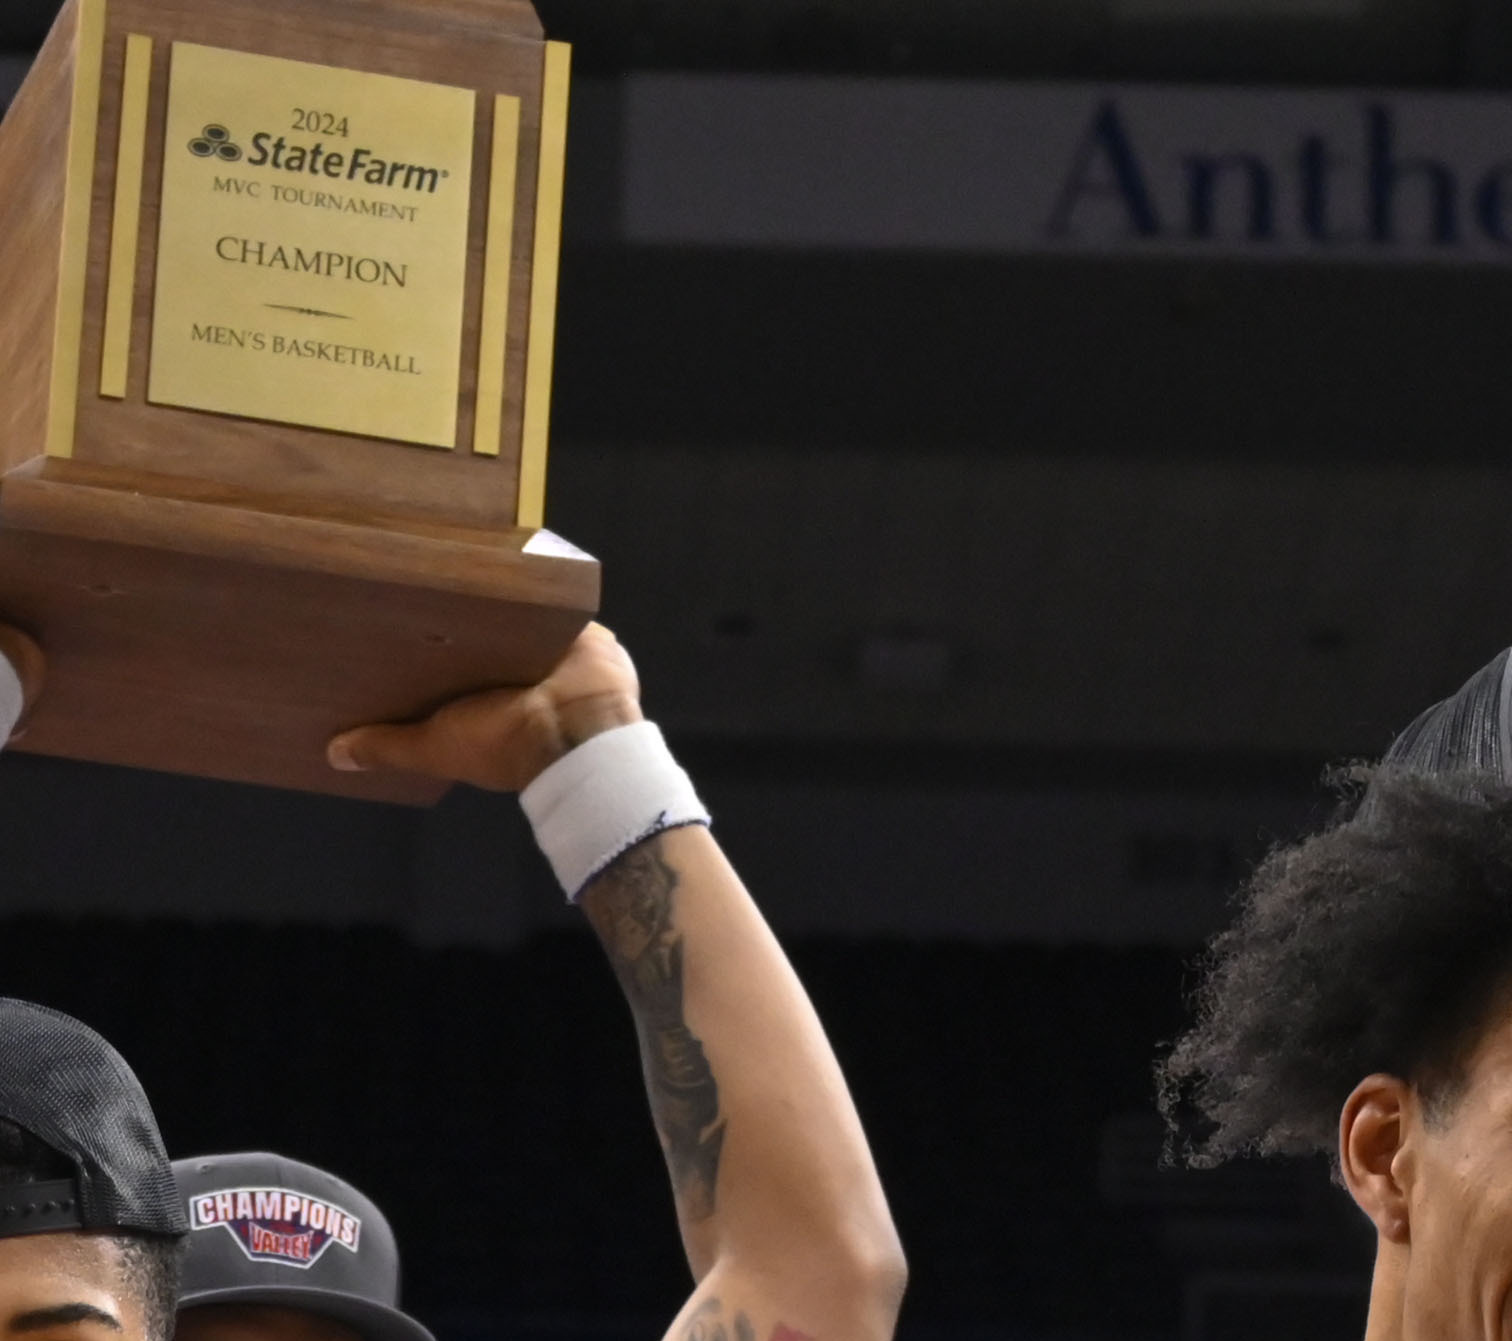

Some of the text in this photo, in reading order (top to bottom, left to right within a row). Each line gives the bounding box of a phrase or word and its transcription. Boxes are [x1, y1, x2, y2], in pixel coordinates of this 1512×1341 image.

[291, 107, 350, 138] 2024
[213, 176, 419, 223] MVC TOURNAMENT
[216, 236, 408, 288] CHAMPION
[191, 323, 422, 375] MEN'S BASKETBALL
[196, 1190, 355, 1243] CHAMPIONS
[248, 1222, 314, 1260] VALLEY
